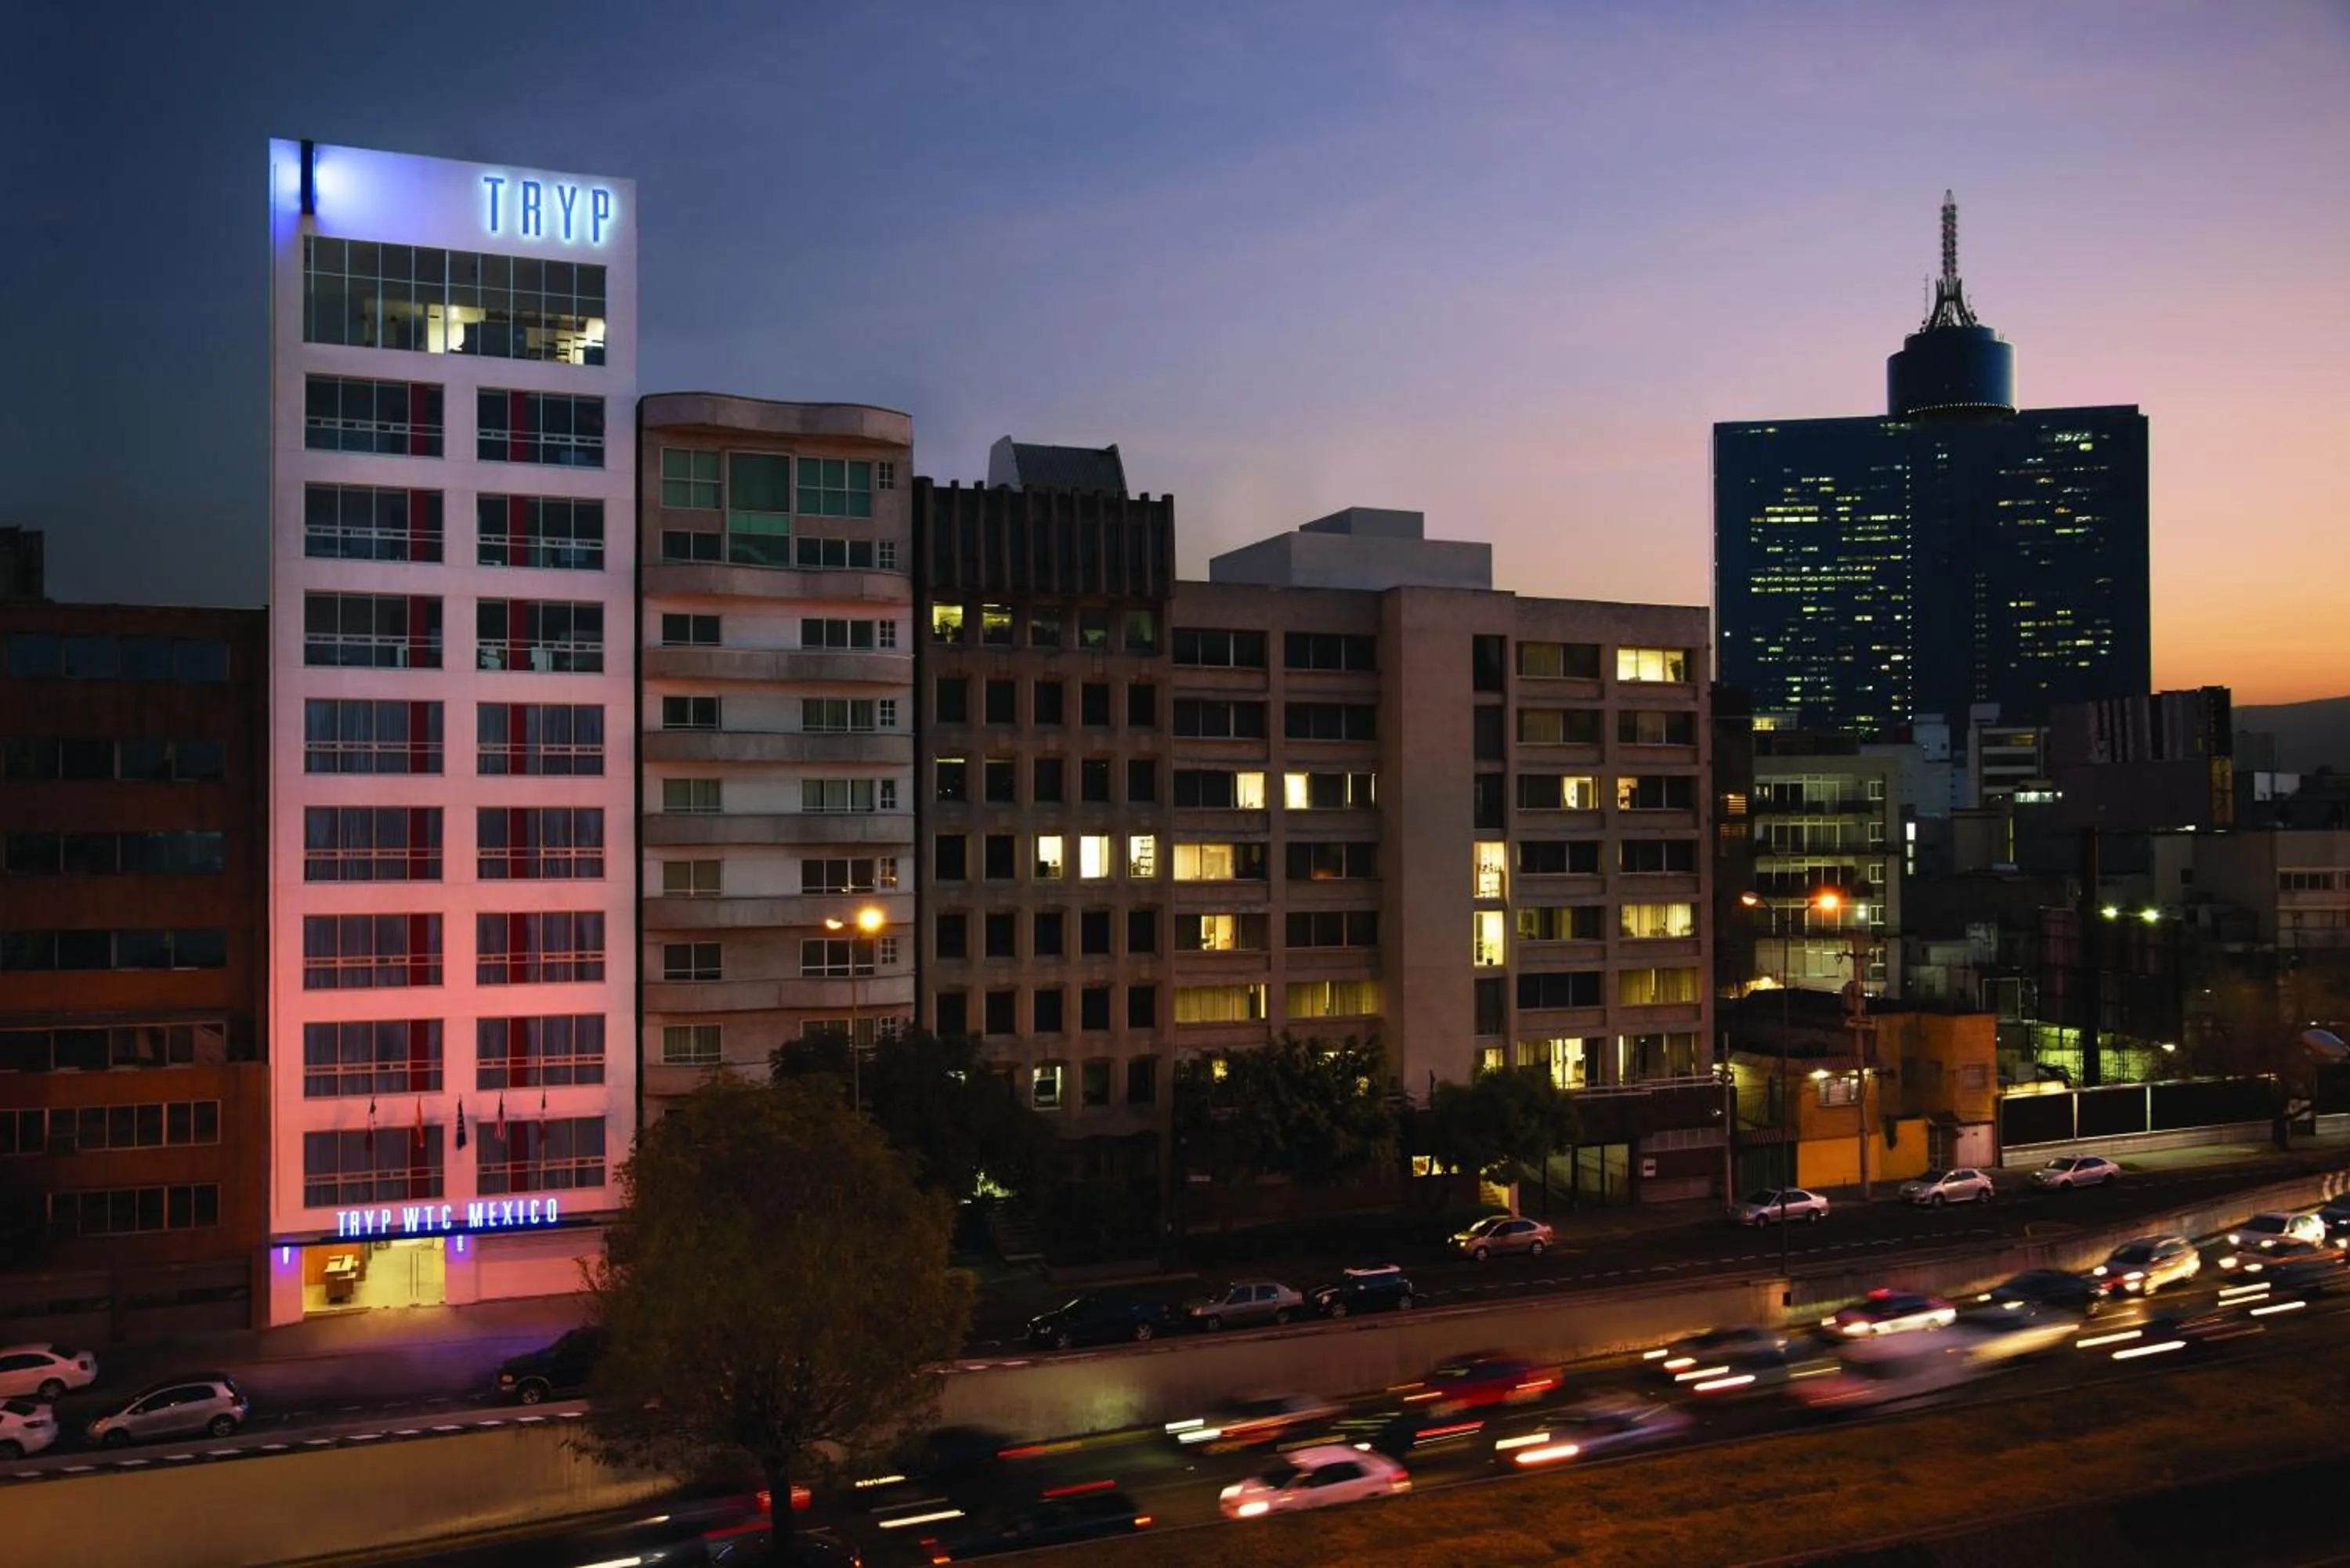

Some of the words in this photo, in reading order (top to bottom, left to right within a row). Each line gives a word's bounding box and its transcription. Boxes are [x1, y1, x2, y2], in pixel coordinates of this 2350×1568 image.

[483, 176, 609, 242] TRYP
[337, 1209, 391, 1237] TRYP
[403, 1205, 452, 1232] WTC
[468, 1198, 557, 1228] MEXICO
